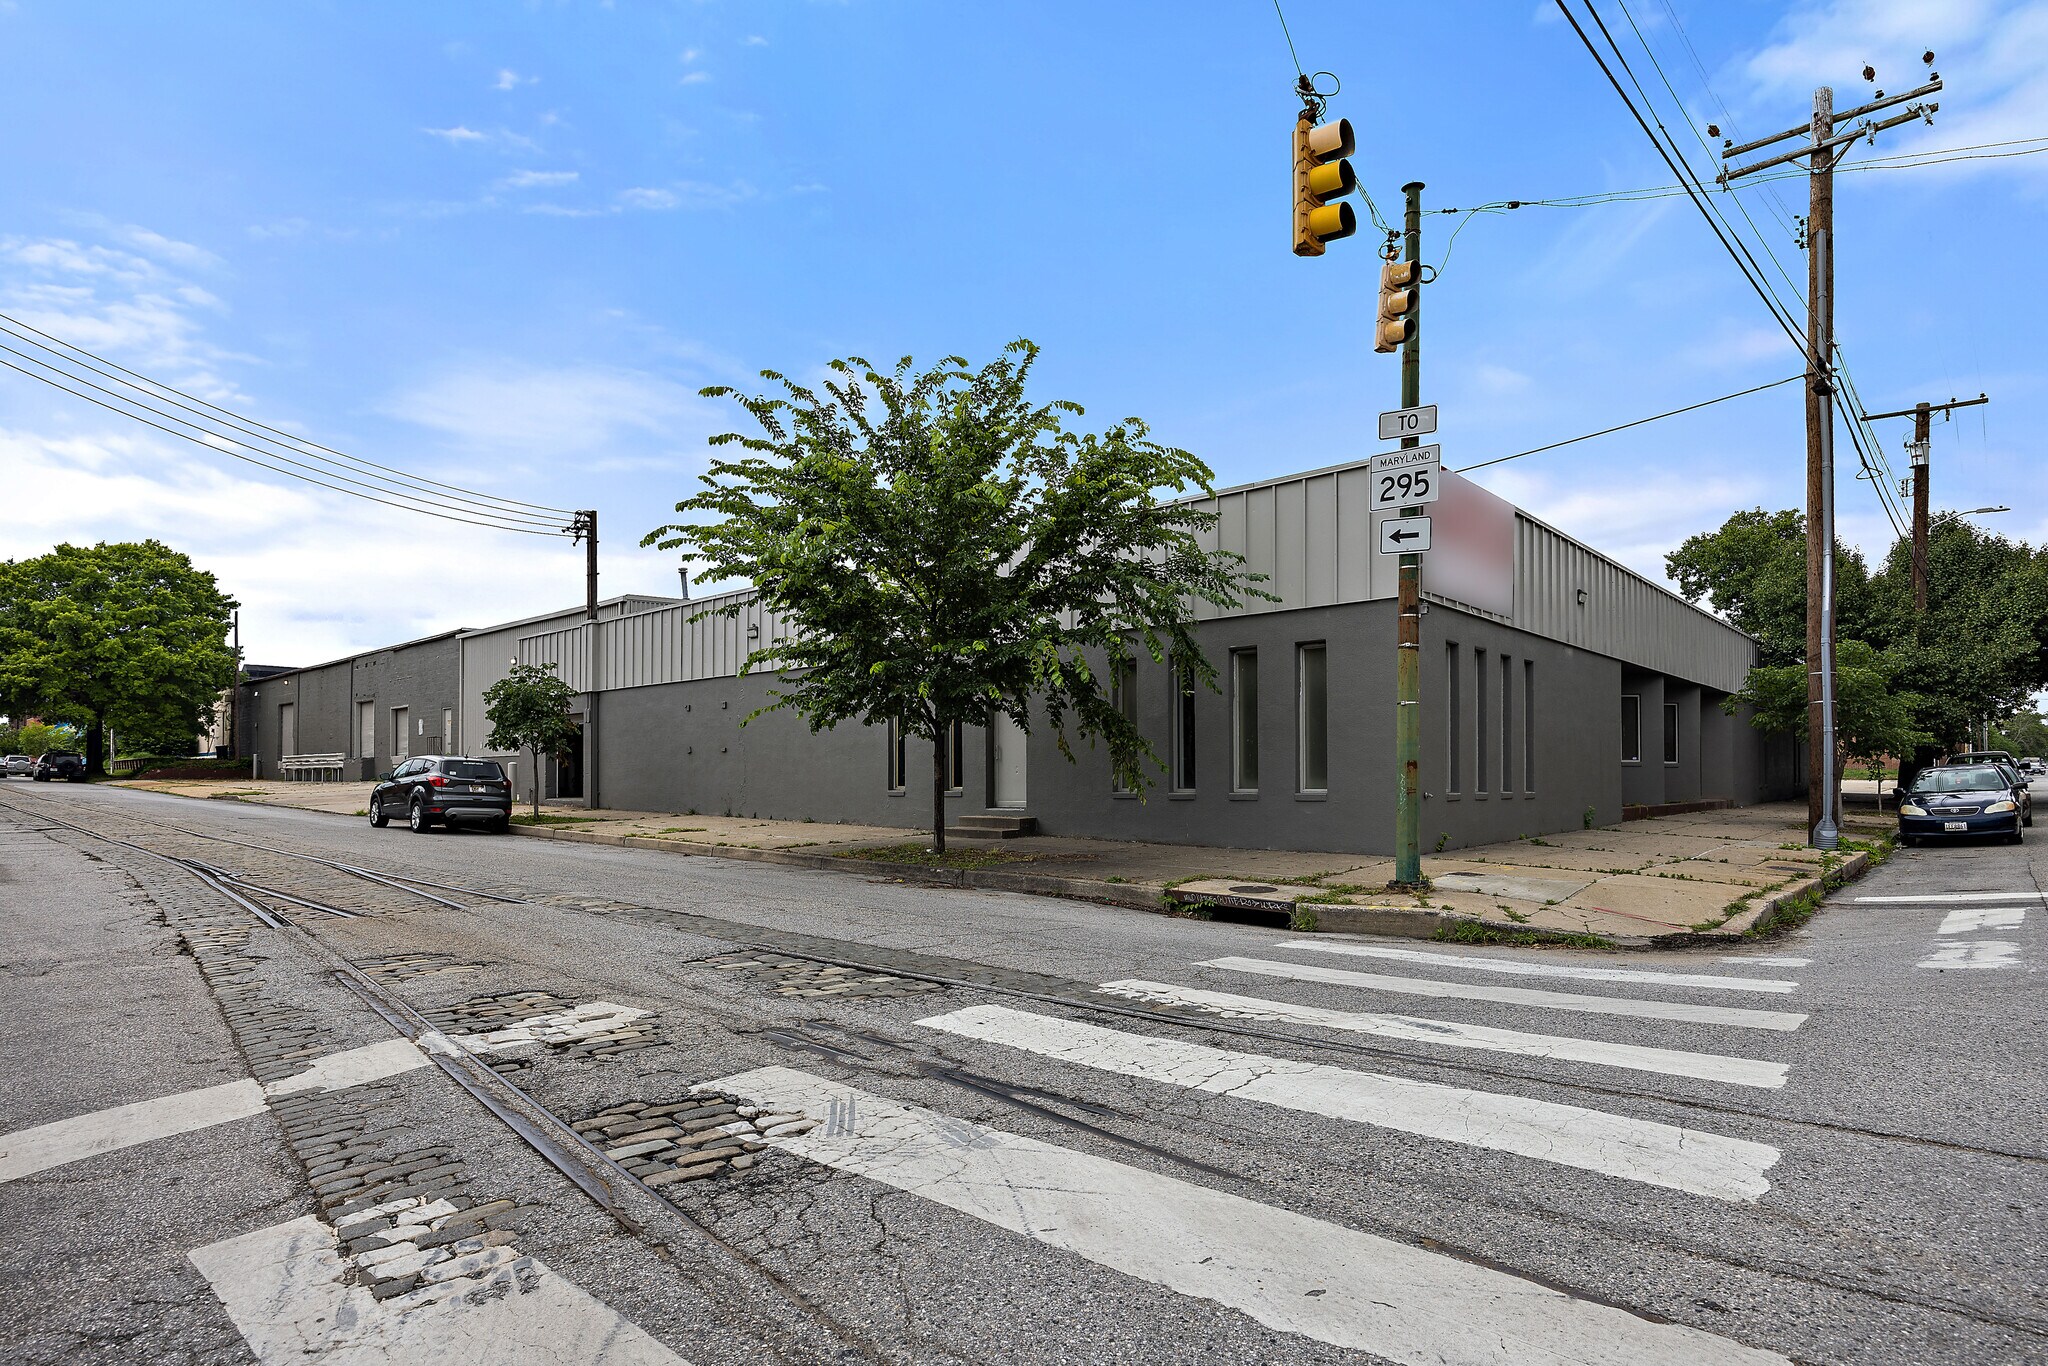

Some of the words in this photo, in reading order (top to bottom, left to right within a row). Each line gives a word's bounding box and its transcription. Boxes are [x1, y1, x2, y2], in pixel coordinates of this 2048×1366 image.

[1397, 413, 1419, 431] TO
[1380, 451, 1431, 468] MARYLAND
[1379, 469, 1430, 502] 295
